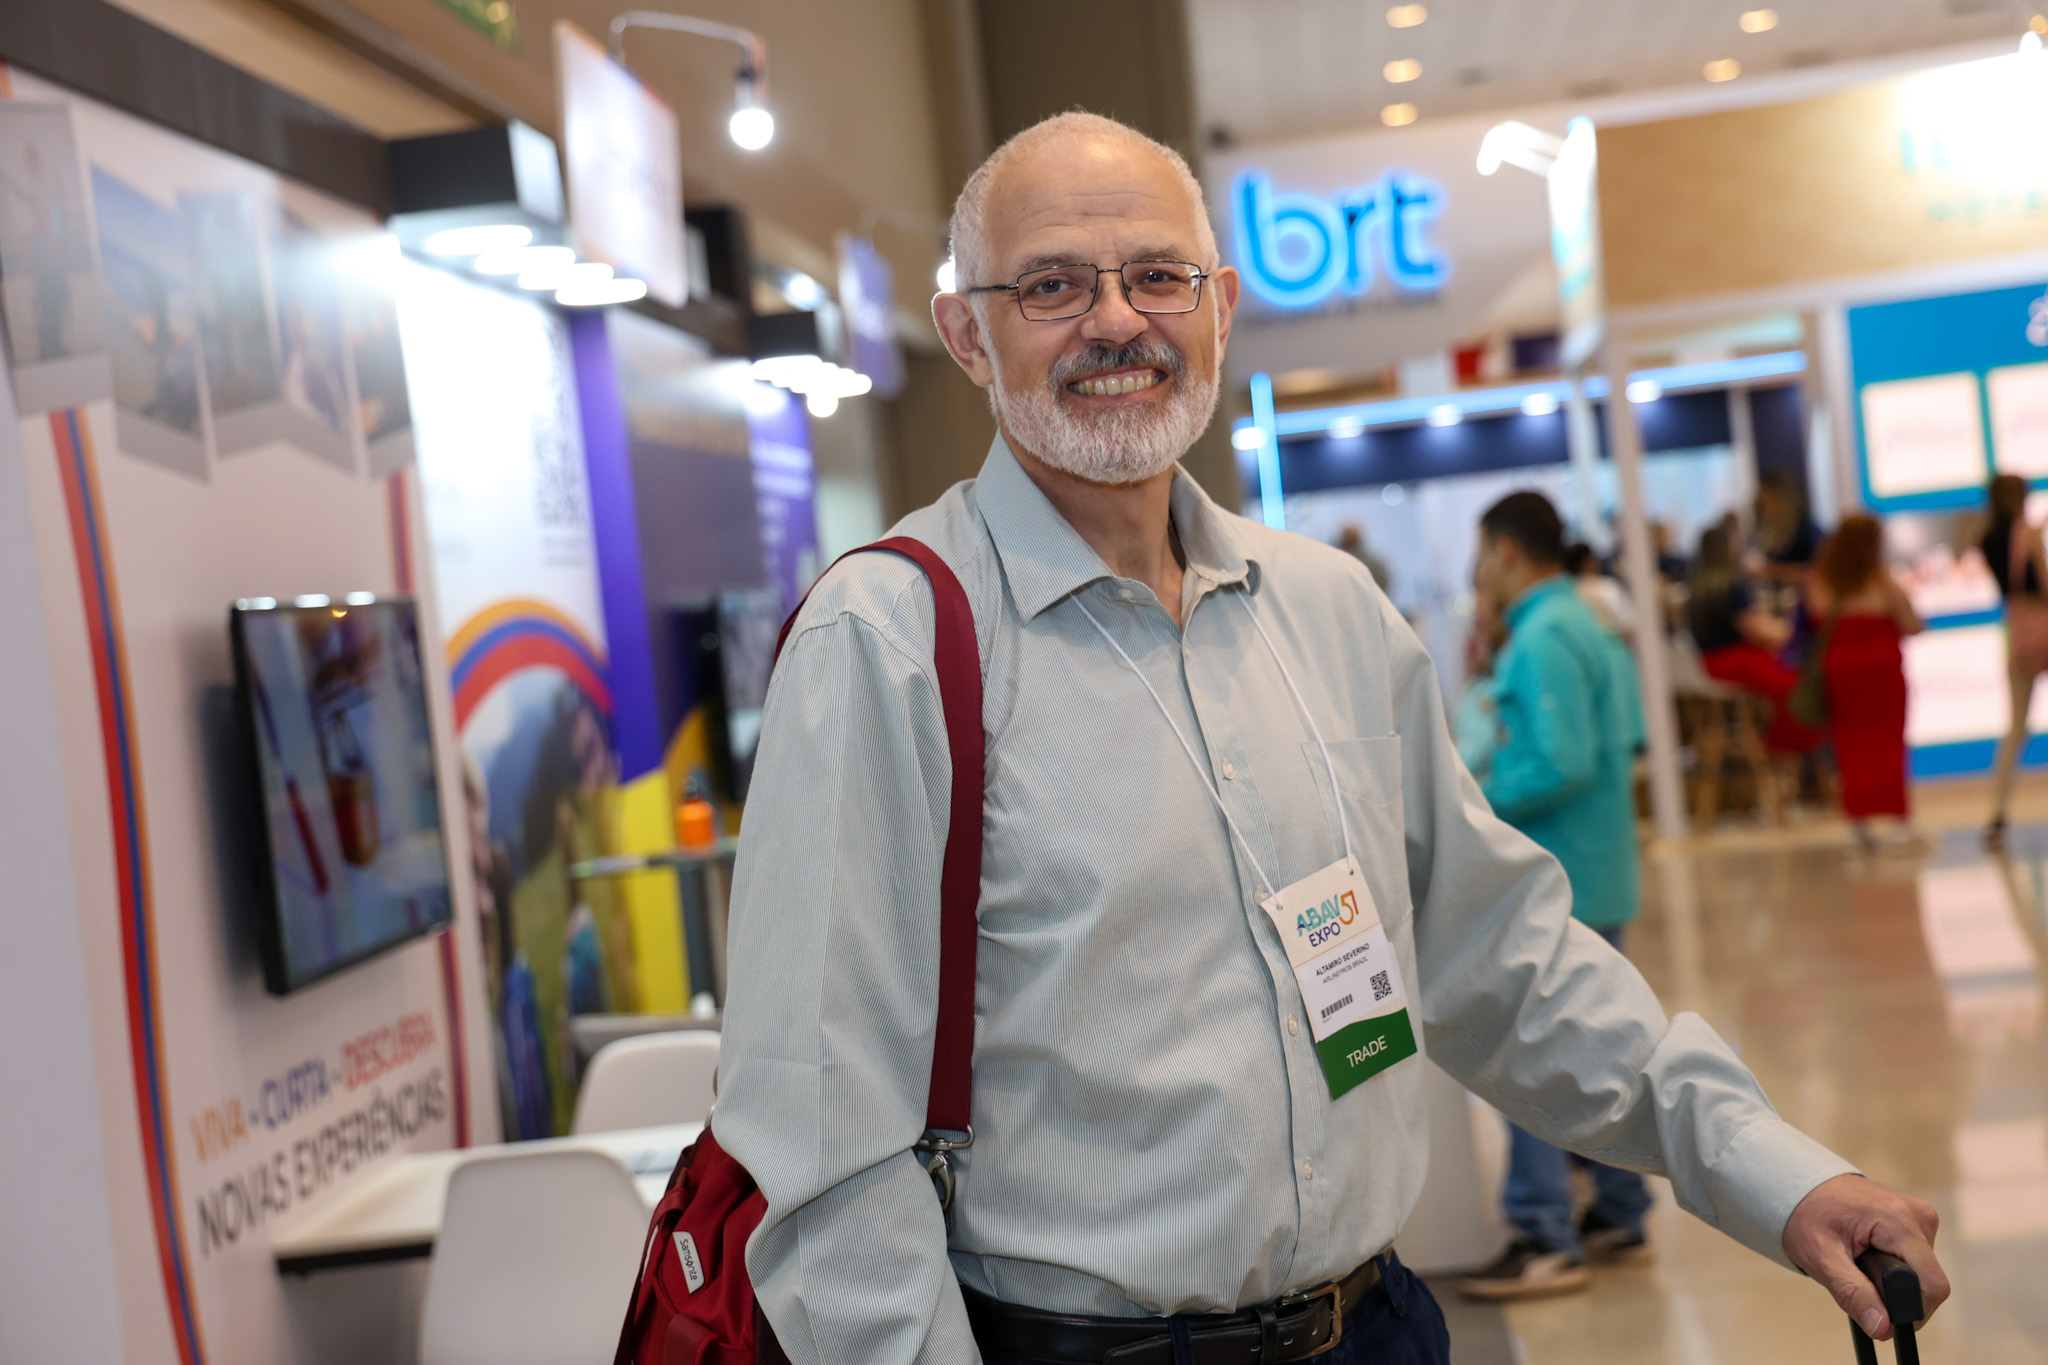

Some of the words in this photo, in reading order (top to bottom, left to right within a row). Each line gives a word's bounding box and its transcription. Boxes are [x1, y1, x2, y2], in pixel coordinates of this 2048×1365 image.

[1234, 170, 1448, 304] brt
[1297, 893, 1340, 938] ABAV
[1339, 889, 1359, 925] 51
[1308, 922, 1341, 948] EXPO
[1316, 957, 1343, 977] ALTAMIRO
[1342, 943, 1370, 962] SEVERINO
[1352, 956, 1369, 970] BRAZIL
[1346, 1035, 1388, 1067] TRADE
[190, 1095, 248, 1164] VIVA
[260, 1057, 332, 1130] CURTA
[341, 1011, 437, 1091] DESCUBRA
[197, 1152, 292, 1257] NOVAS
[680, 1238, 698, 1281] Samsonite
